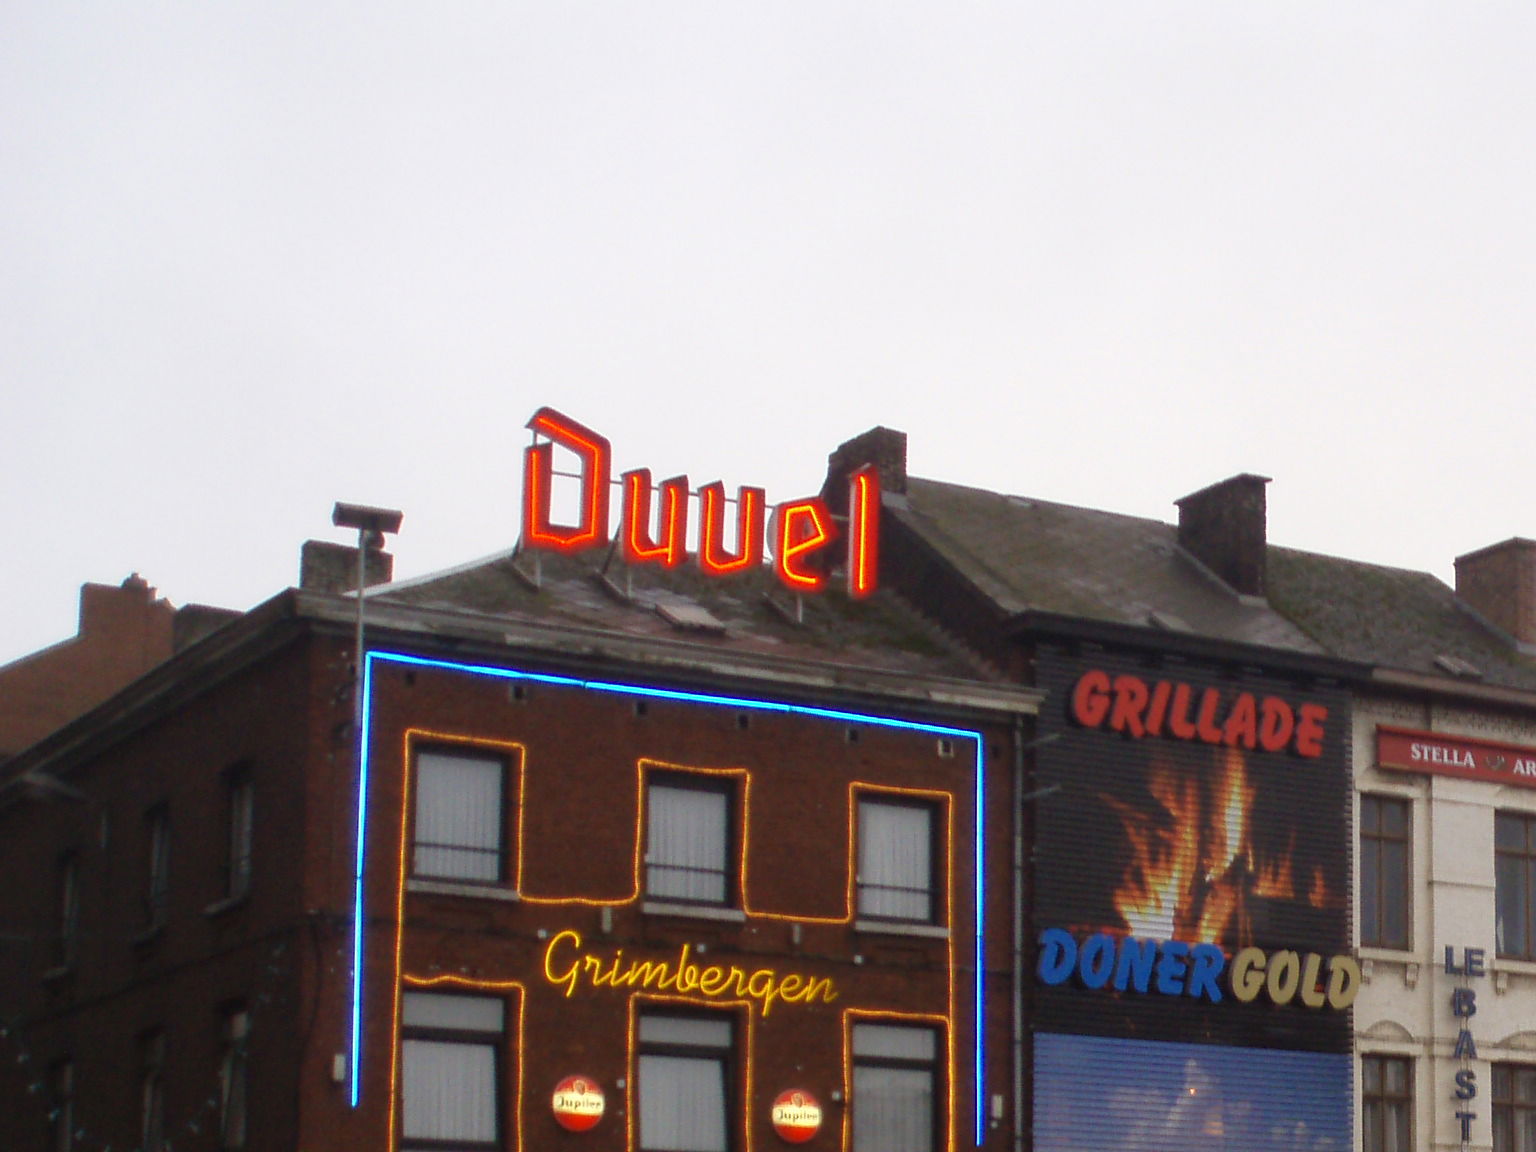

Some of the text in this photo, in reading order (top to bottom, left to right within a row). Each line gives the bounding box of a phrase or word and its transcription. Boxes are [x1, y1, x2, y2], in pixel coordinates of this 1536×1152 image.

[522, 406, 879, 598] Duvel
[1073, 670, 1328, 757] GRILLADE
[1411, 743, 1475, 768] STELLA
[545, 930, 839, 1017] Grimbergen
[1038, 928, 1360, 1009] DONER GOLD
[1445, 944, 1485, 977] LE
